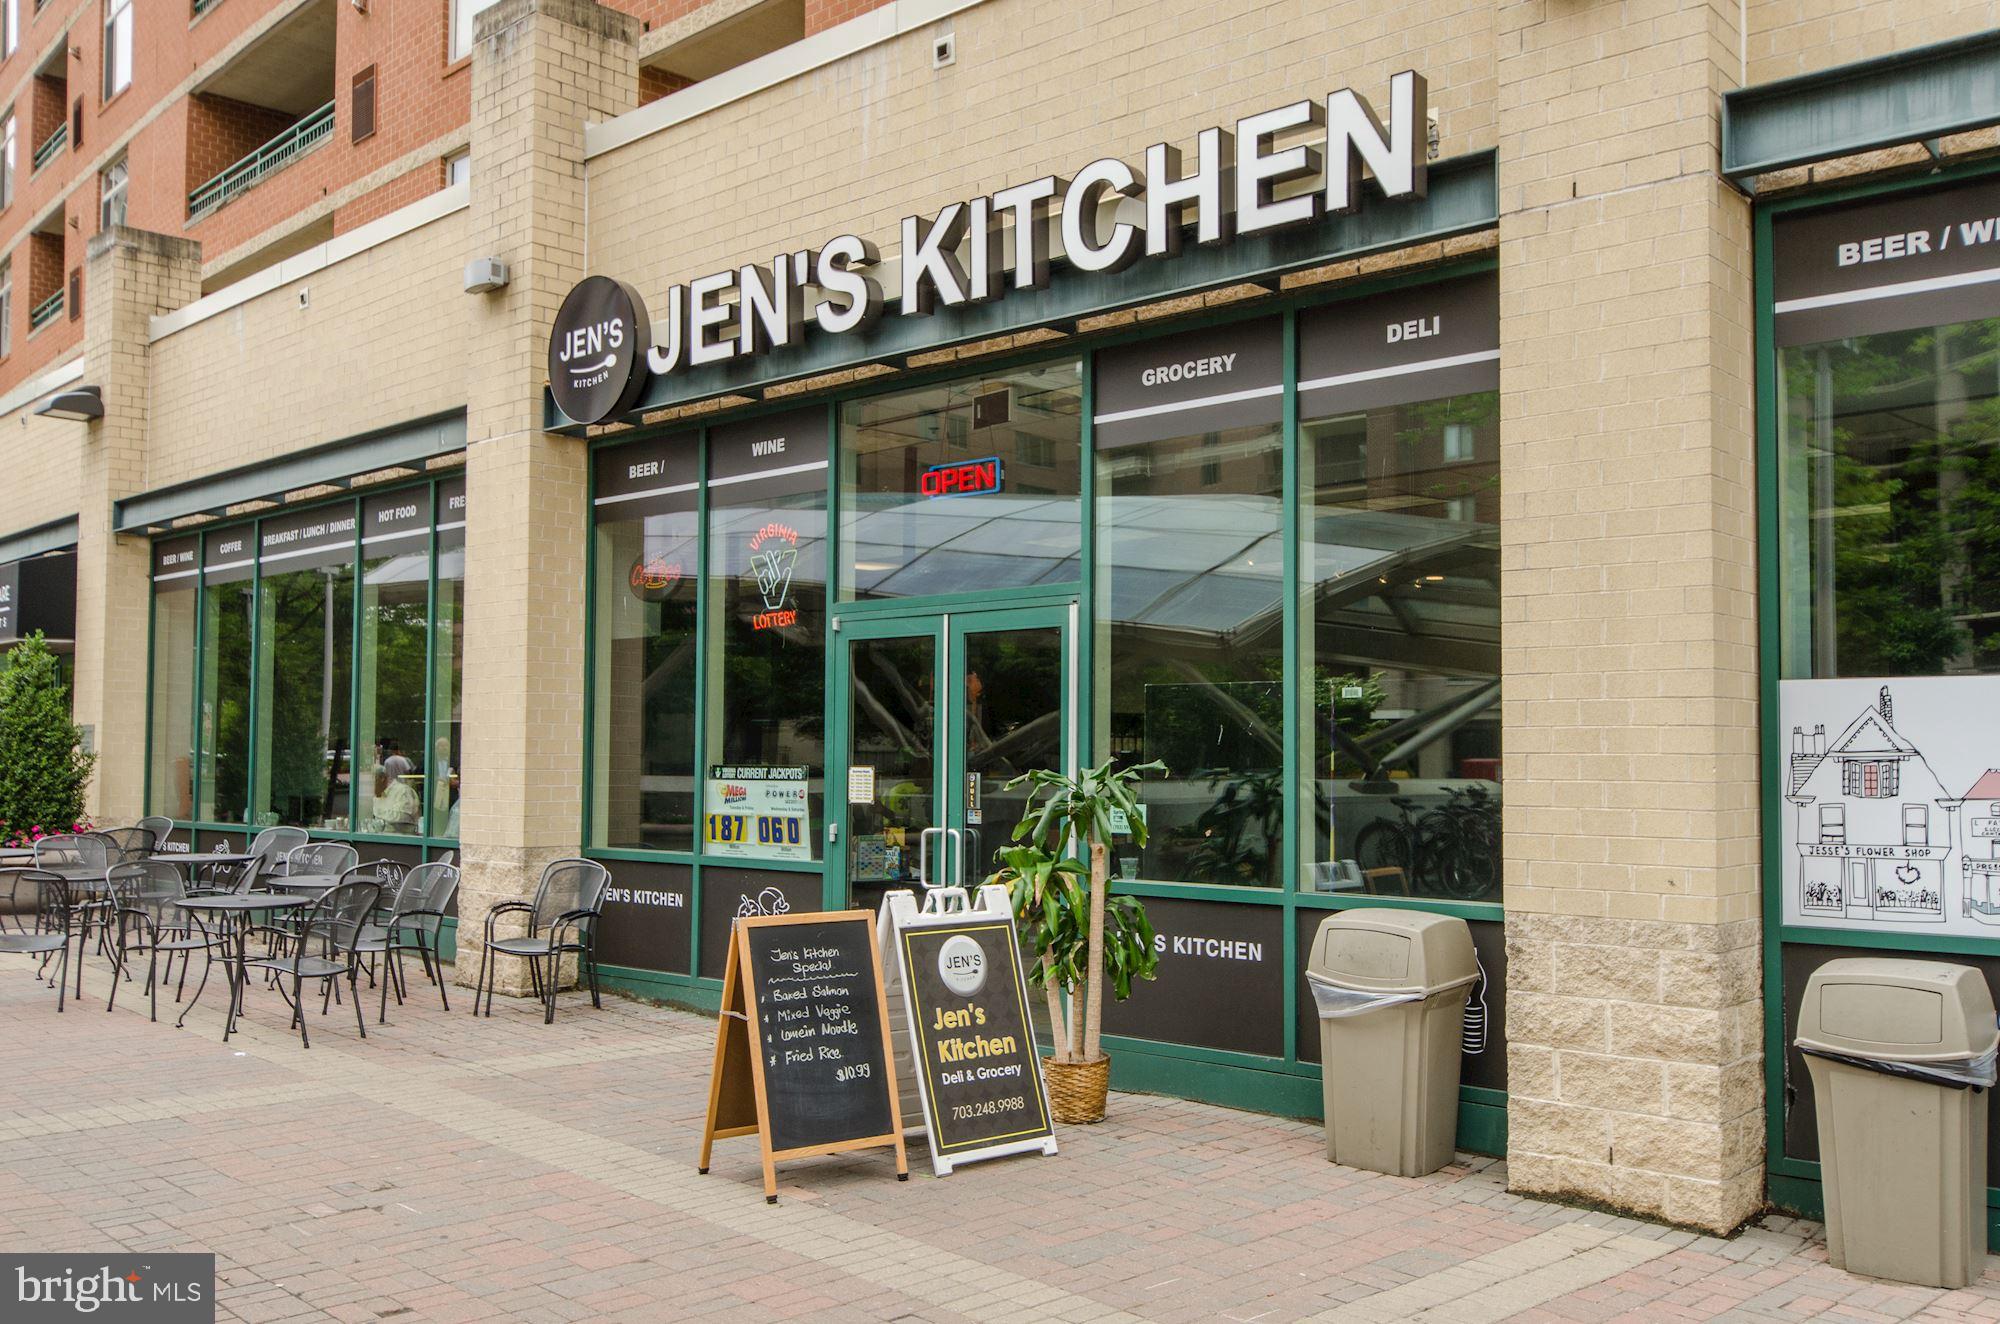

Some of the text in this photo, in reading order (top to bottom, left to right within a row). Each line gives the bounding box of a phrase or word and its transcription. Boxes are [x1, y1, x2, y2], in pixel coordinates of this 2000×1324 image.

[646, 69, 1427, 376] JEN'S KITCHEN
[1838, 230, 1932, 267] BEER
[1940, 225, 1951, 250] /
[1386, 316, 1440, 343] DELI
[560, 318, 624, 362] JEN'S
[574, 370, 609, 388] KITCHEN
[1141, 353, 1237, 386] GROCERY
[629, 438, 785, 479] BEER / WINE
[921, 462, 996, 496] OPEN
[449, 495, 467, 509] FRE
[378, 505, 416, 523] HOT FOOD
[263, 529, 299, 547] BREAKFAST
[303, 525, 325, 539] LUNCH
[330, 518, 355, 534] DINNER
[750, 520, 798, 551] VIRGINIA
[220, 540, 242, 554] COFFEE
[163, 555, 177, 566] BEER
[180, 551, 194, 562] WINE
[753, 609, 796, 630] LOTTERY
[736, 767, 768, 779] CURRENT
[768, 767, 802, 779] JACKPOTS
[726, 784, 747, 797] MEGA
[765, 790, 798, 799] POWER
[709, 815, 743, 841] 187
[758, 816, 800, 844] 060
[167, 841, 190, 853] KITCHEN
[1809, 845, 1931, 858] JESSE'S FLOWER SHOP
[633, 890, 683, 907] KITCHEN
[770, 948, 799, 961] Jen's
[1173, 935, 1263, 962] KITCHEN
[792, 960, 832, 979] Special
[946, 954, 982, 969] JEN'S
[812, 985, 849, 997] Salmon
[777, 1004, 851, 1022] Mixed Veggie
[933, 1003, 986, 1030] Jen's
[821, 1020, 858, 1035] Noodle
[785, 1045, 842, 1065] Fried Rice
[937, 1035, 1017, 1063] Kitchen
[941, 1063, 1022, 1085] Deli & Grocery
[952, 1096, 1025, 1120] 703.248.9988
